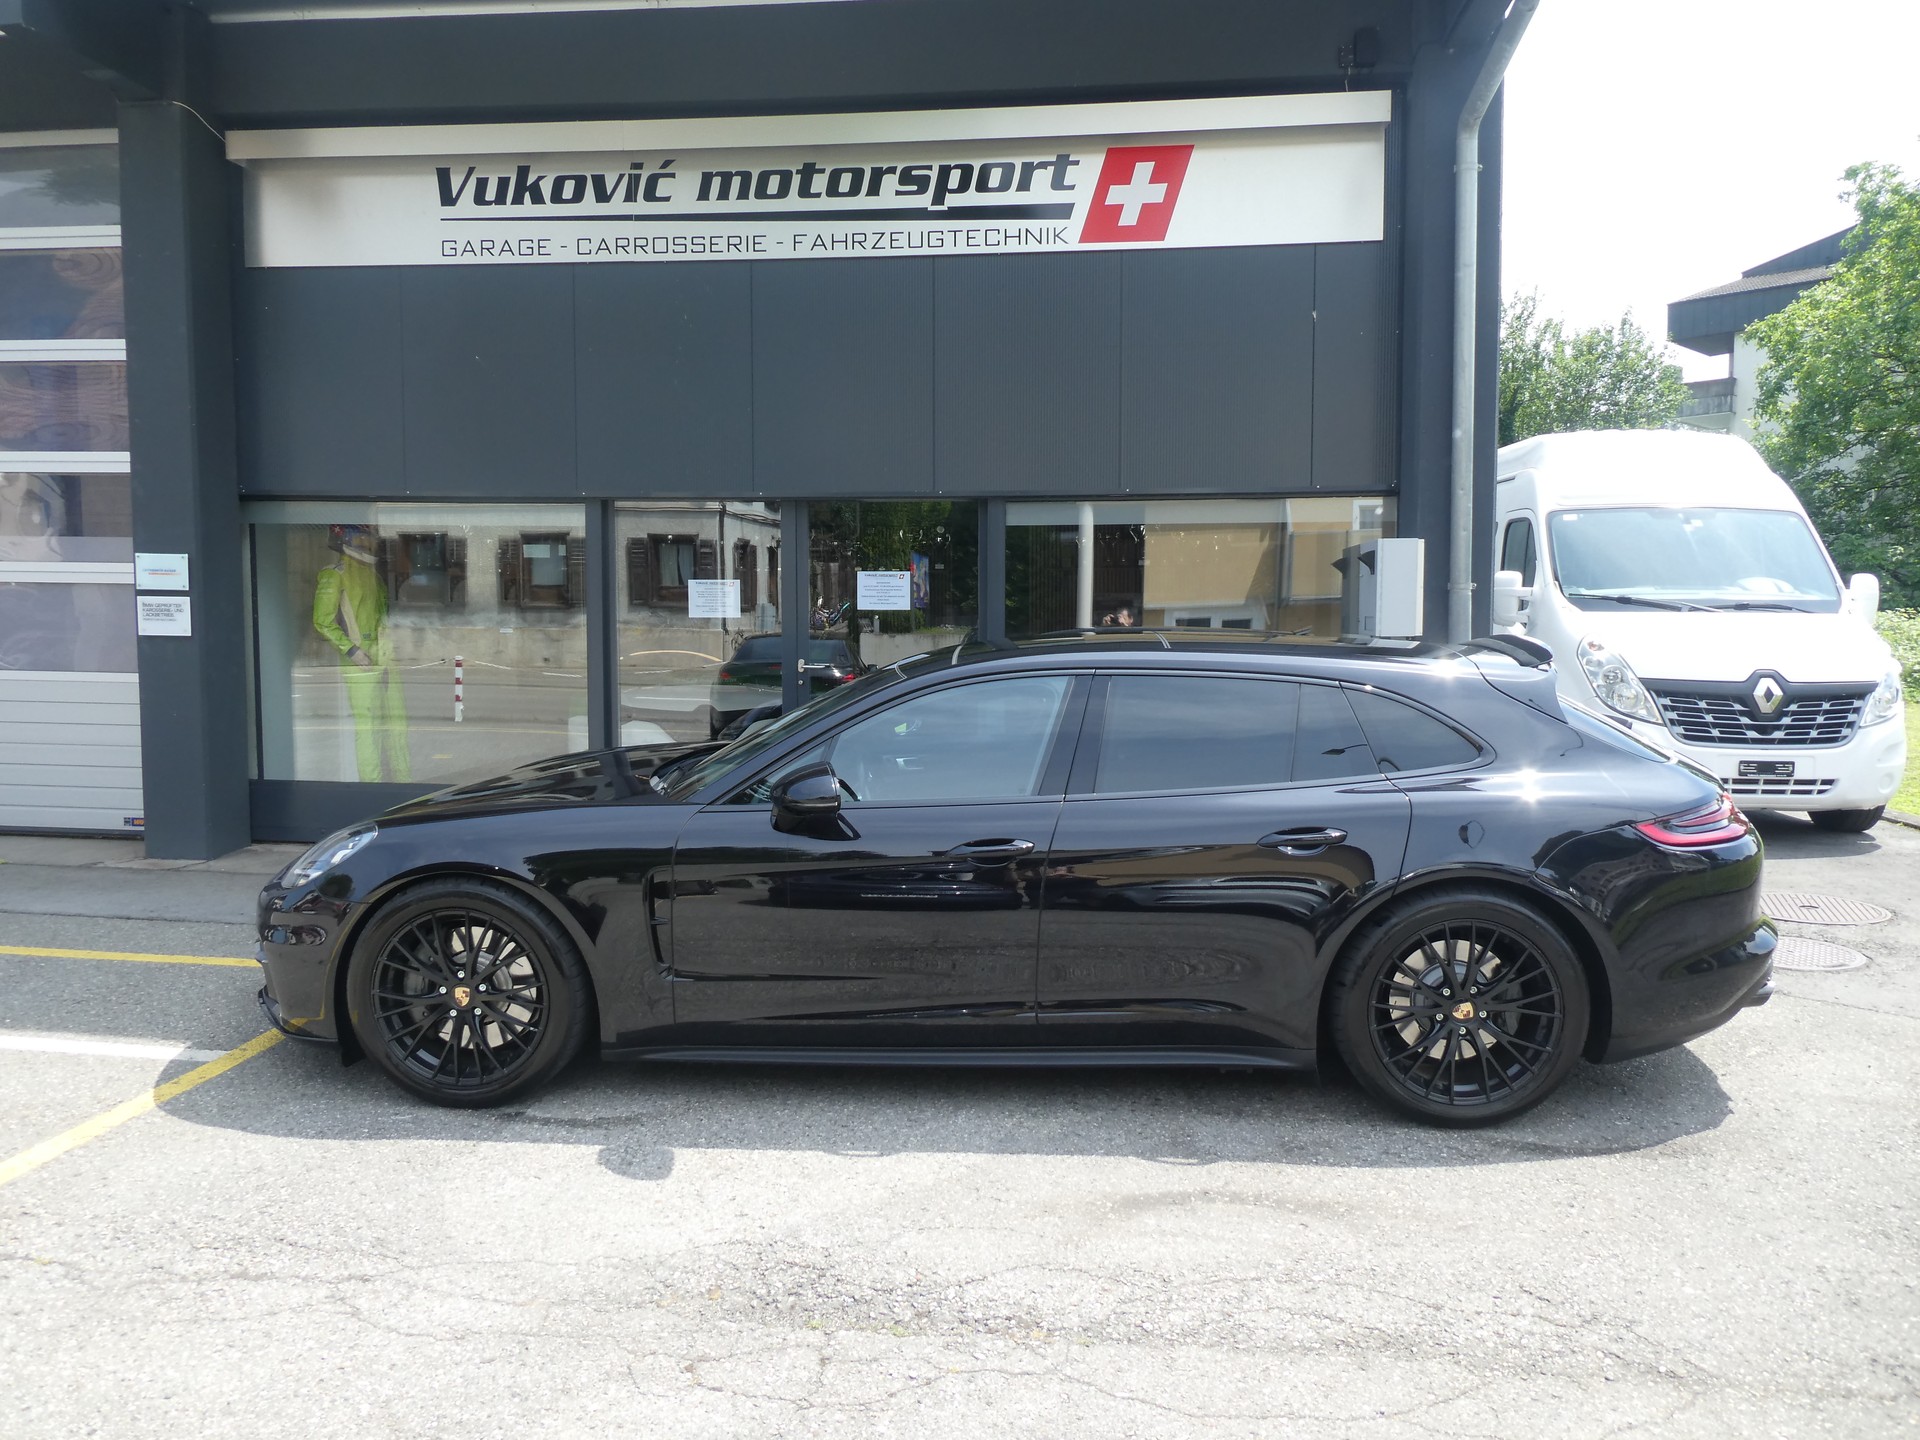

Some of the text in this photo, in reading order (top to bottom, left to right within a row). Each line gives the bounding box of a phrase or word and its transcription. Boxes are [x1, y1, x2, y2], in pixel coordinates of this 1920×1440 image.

[435, 153, 1081, 207] Vuković motorsport
[441, 238, 552, 257] GARAGE
[576, 235, 767, 255] CARROSSERIE
[793, 226, 1069, 251] FAHRZEUGTECHNIK
